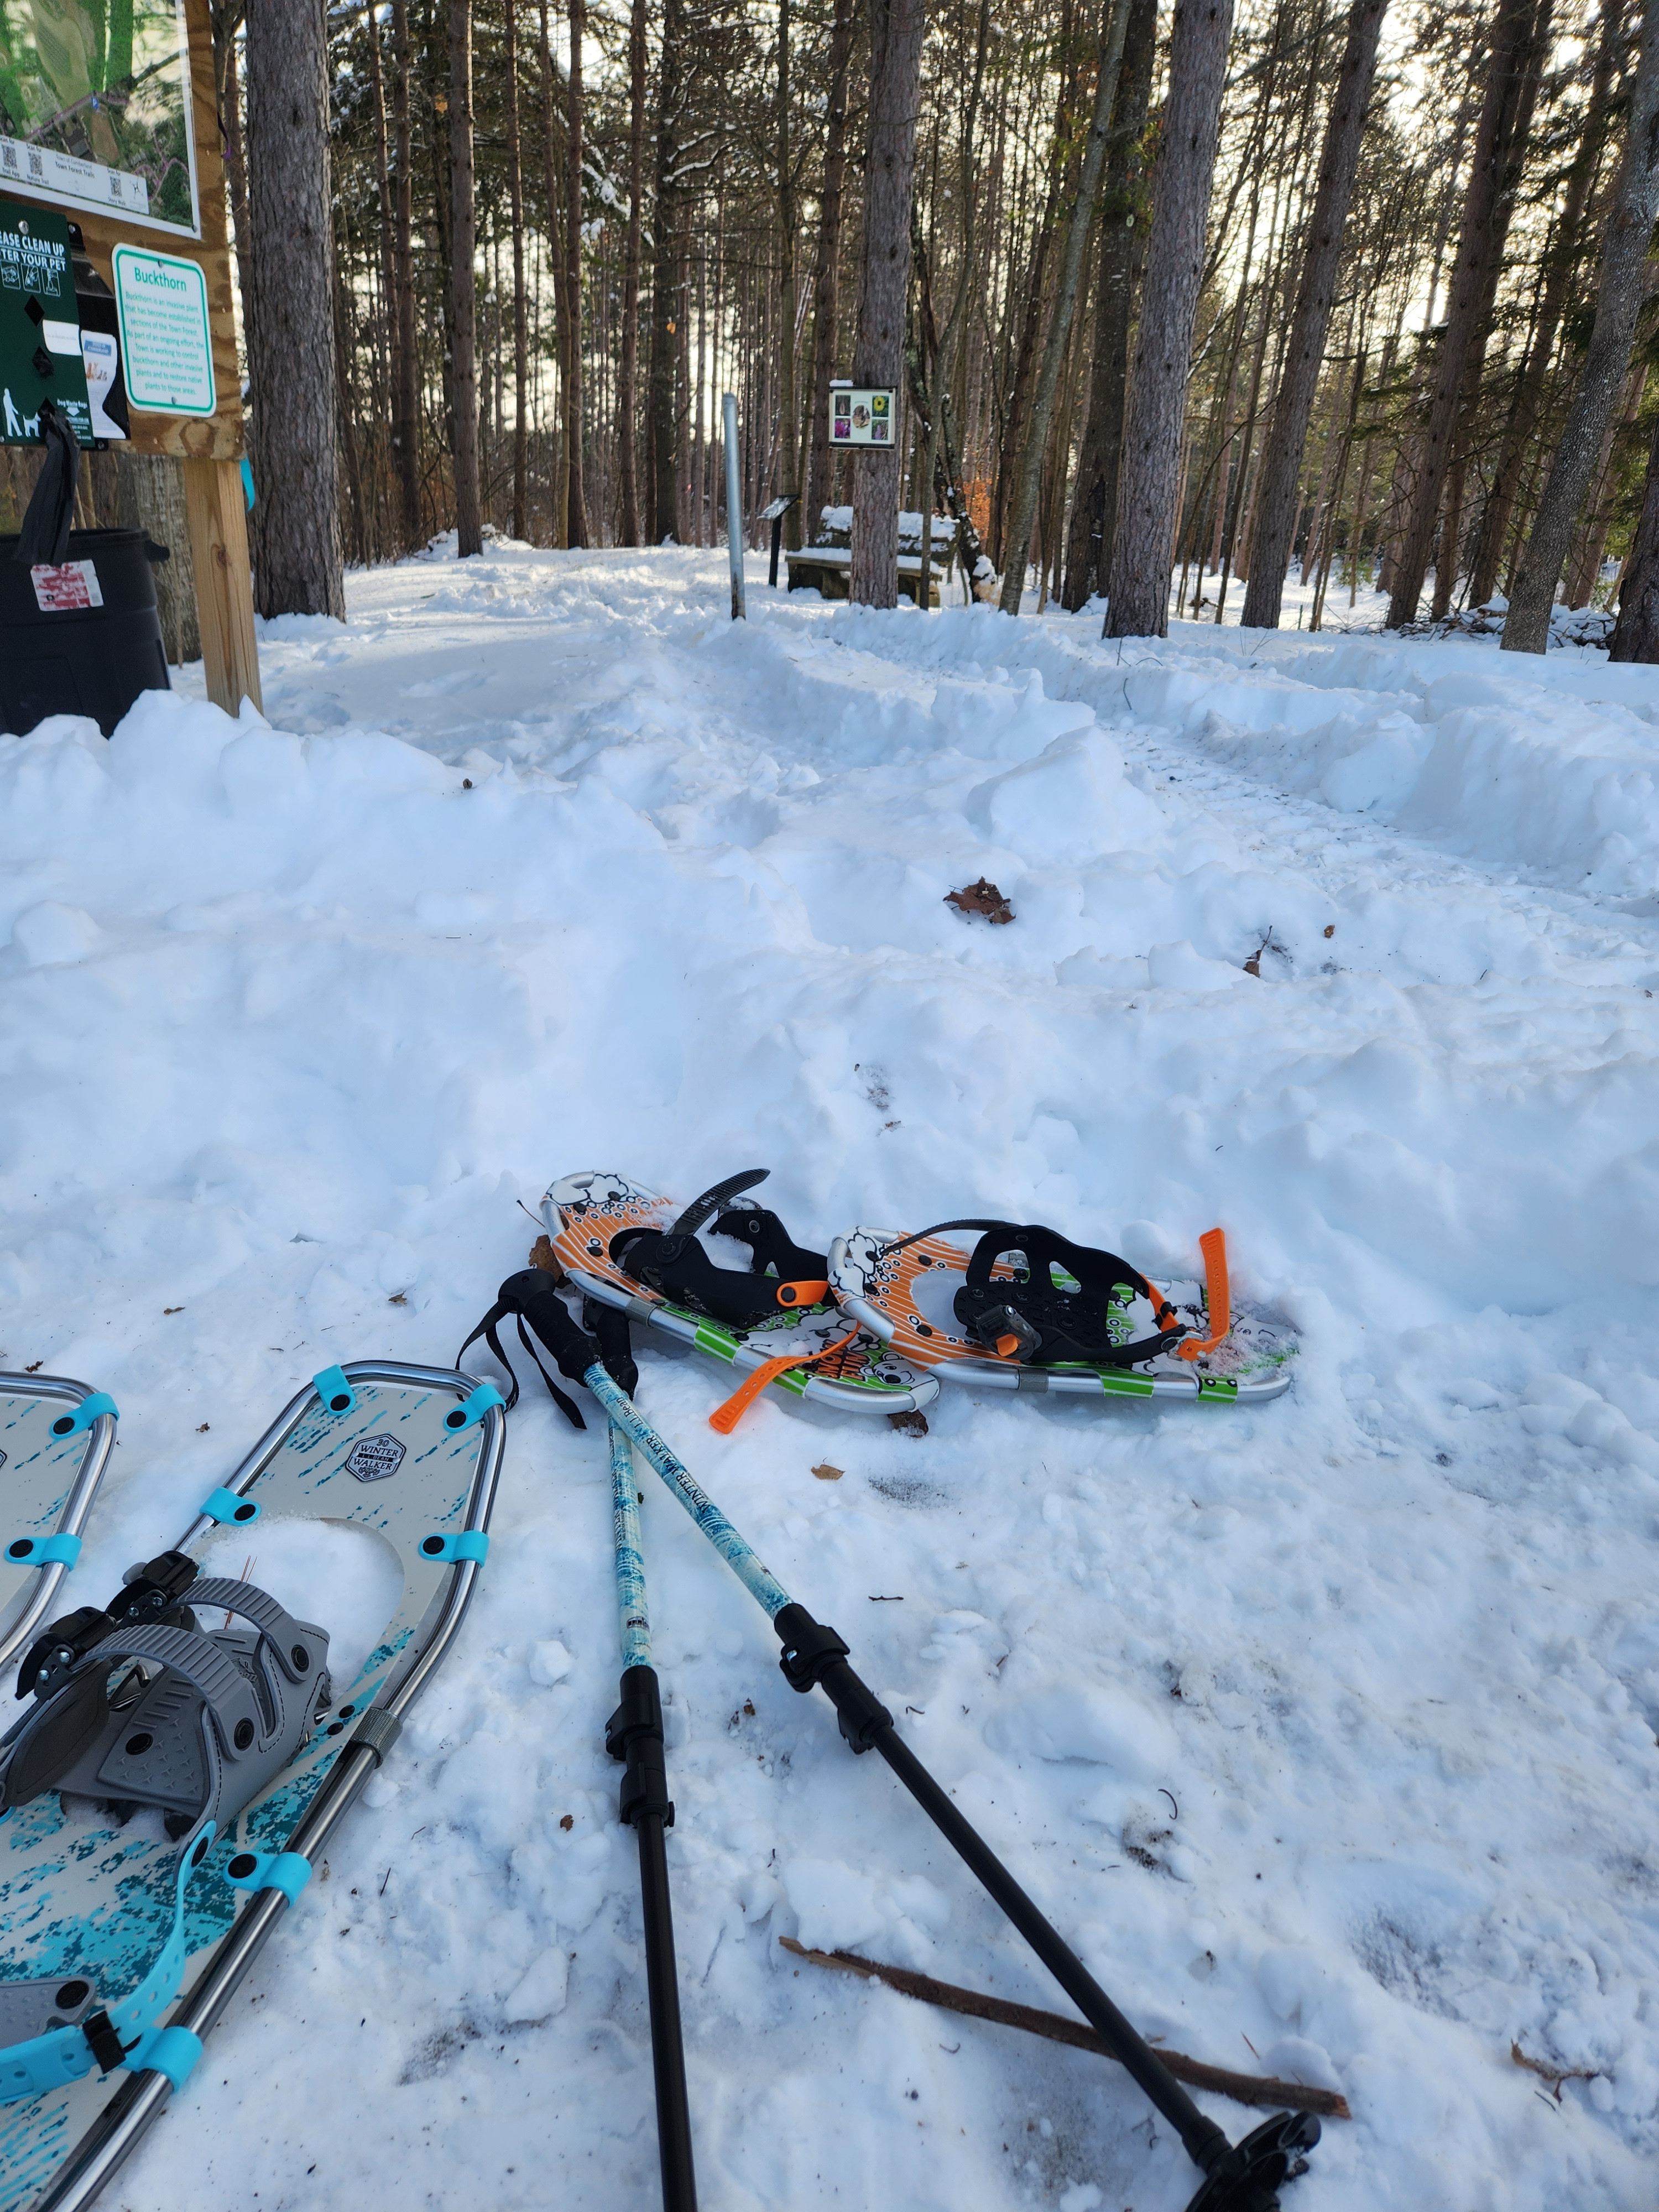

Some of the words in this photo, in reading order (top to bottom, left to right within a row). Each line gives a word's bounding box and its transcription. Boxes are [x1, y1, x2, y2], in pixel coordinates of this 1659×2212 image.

[55, 160, 67, 170] Town
[69, 165, 82, 175] Forest
[84, 169, 95, 179] Trails
[22, 236, 51, 254] CLEAN
[52, 241, 64, 257] UP
[0, 248, 20, 262] TER
[21, 252, 48, 267] YOUR
[49, 258, 66, 272] PET
[134, 267, 186, 291] Buckthorn
[126, 291, 152, 303] Buckthorn
[166, 301, 185, 310] invasive
[186, 304, 199, 313] plant
[125, 304, 136, 314] that
[137, 306, 147, 315] has
[147, 307, 168, 319] become
[168, 314, 196, 325] established
[131, 319, 152, 328] sections
[159, 323, 168, 331] the
[169, 324, 181, 333] Town
[127, 329, 133, 337] As
[160, 336, 180, 347] ongoing
[196, 341, 205, 349] the
[136, 342, 148, 352] Town
[155, 347, 175, 358] working
[182, 352, 199, 361] control
[133, 354, 159, 366] buckthorn
[160, 359, 170, 368] and
[170, 361, 184, 370] other
[185, 363, 203, 373] invasive
[136, 369, 152, 377] plants
[170, 374, 187, 382] restore
[188, 375, 202, 384] native
[145, 382, 160, 390] plants
[168, 384, 181, 393] those
[57, 398, 66, 408] Dog
[78, 400, 88, 409] Bags
[839, 1350, 870, 1381] FUN
[361, 1444, 399, 1457] WINTER
[377, 1438, 389, 1447] 30
[353, 1458, 393, 1470] WALKER
[646, 1435, 680, 1475] WALKER
[676, 1472, 711, 1514] WINTER
